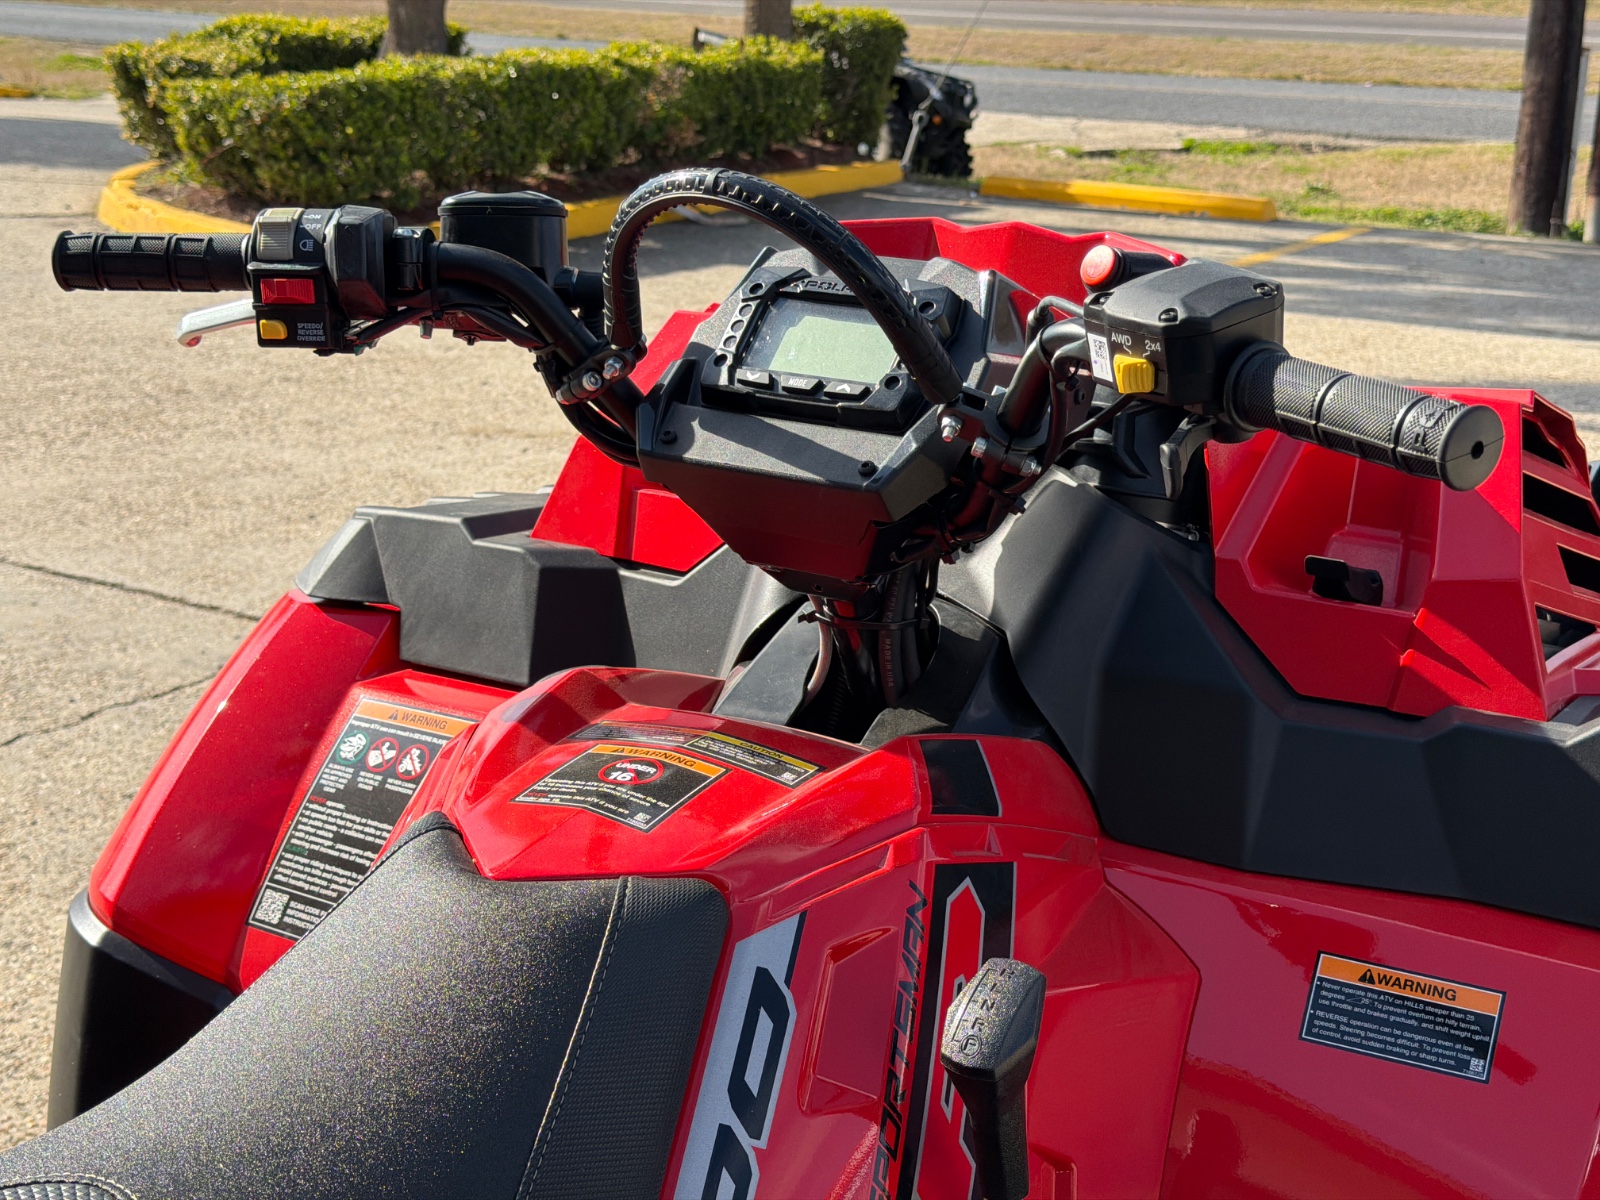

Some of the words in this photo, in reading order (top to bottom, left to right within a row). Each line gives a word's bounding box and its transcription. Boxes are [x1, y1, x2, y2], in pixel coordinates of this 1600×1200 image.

[1111, 332, 1132, 346] AWD
[1144, 340, 1162, 352] 2x4
[787, 378, 808, 387] MODE
[401, 711, 448, 730] WARNING
[628, 748, 697, 768] WARNING
[740, 742, 783, 759] CAUTION
[608, 771, 635, 781] 16
[615, 762, 657, 774] UNDER
[1376, 973, 1457, 1001] WARNING
[980, 999, 996, 1012] N
[1322, 982, 1340, 990] Never
[1342, 987, 1365, 996] operate
[1404, 1001, 1424, 1009] HILLS
[1425, 1006, 1448, 1015] steeper
[1320, 990, 1345, 1000] degrees
[1383, 1005, 1406, 1014] prevent
[1445, 1018, 1458, 1027] hilly
[1316, 1010, 1347, 1022] REVERSE
[1350, 1020, 1378, 1029] operation
[1403, 1032, 1436, 1043] dangerous
[1331, 1001, 1352, 1010] throttle
[1367, 1009, 1388, 1018] brakes
[1450, 1029, 1470, 1037] weight
[1340, 1025, 1365, 1036] Steering
[1367, 1031, 1394, 1042] becomes
[1423, 1043, 1430, 1051] To
[1432, 1047, 1456, 1056] prevent
[1458, 1052, 1470, 1060] loss
[1362, 1040, 1384, 1048] sudden
[1386, 1045, 1409, 1056] braking
[1419, 1053, 1437, 1061] sharp
